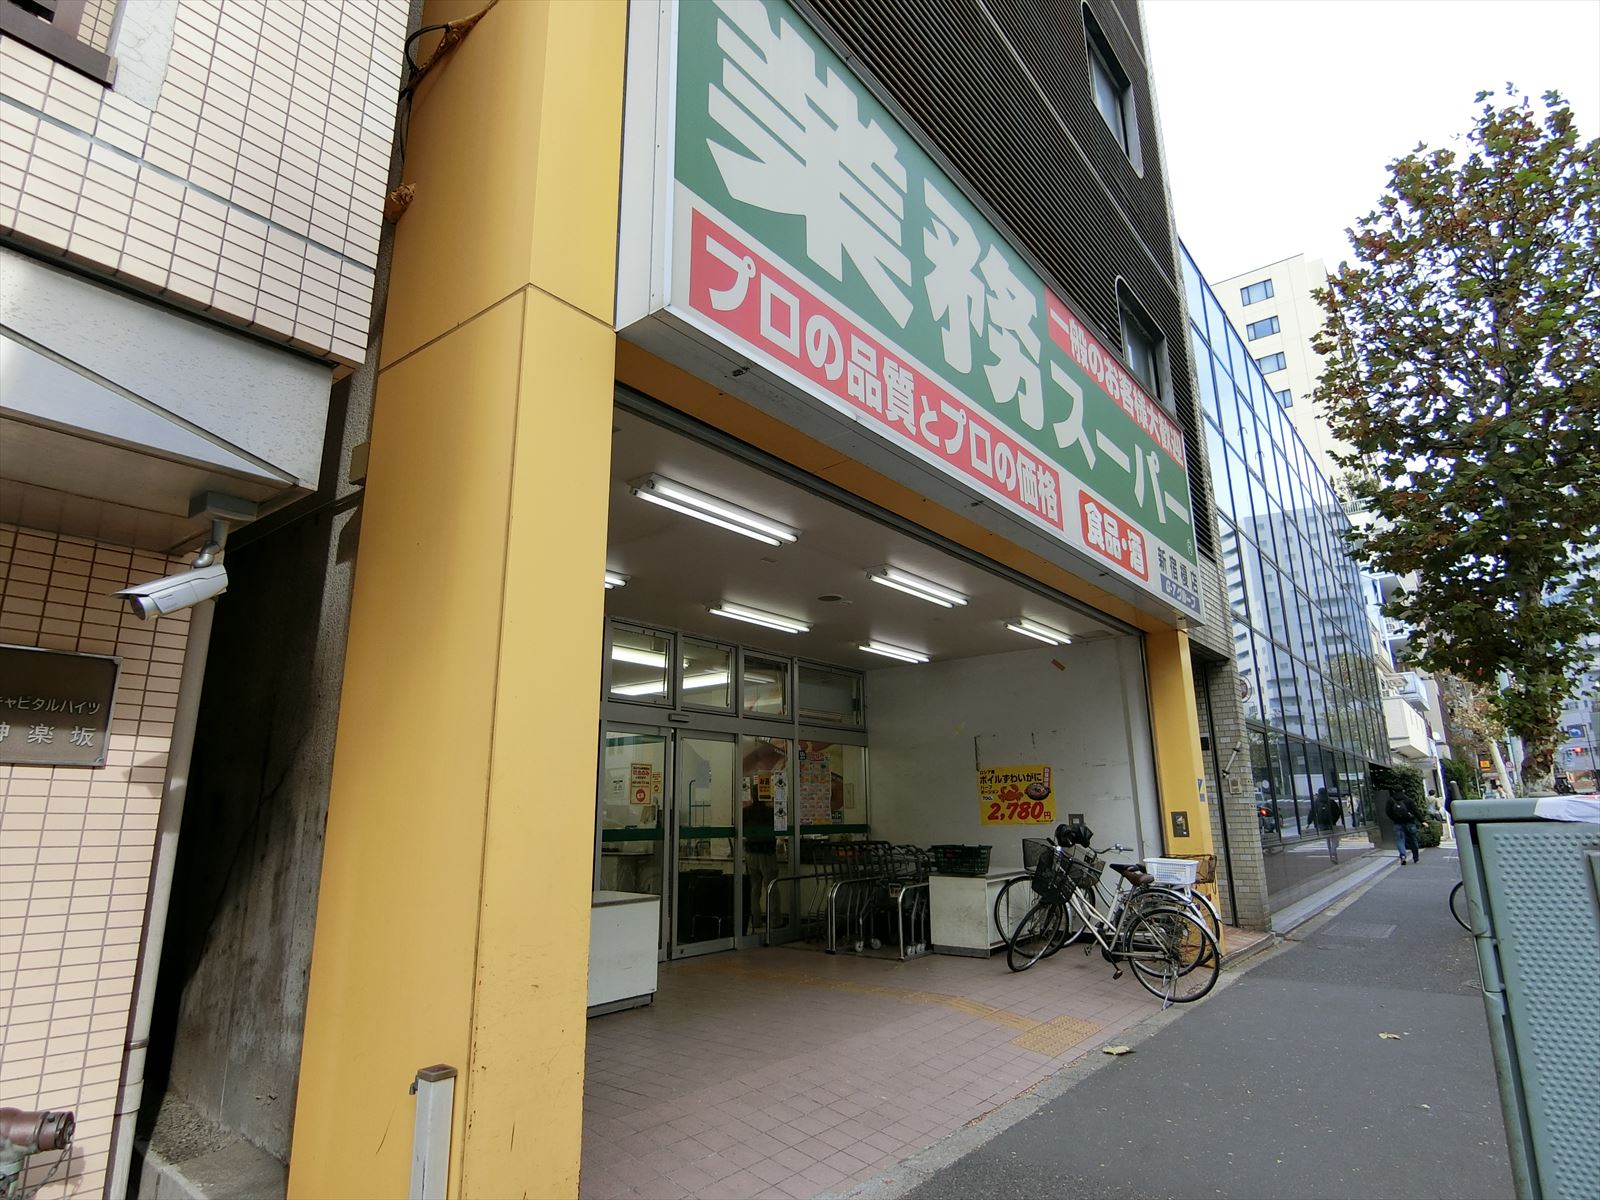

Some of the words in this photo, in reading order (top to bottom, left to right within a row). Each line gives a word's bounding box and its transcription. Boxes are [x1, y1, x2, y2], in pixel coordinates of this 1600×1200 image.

[706, 0, 1190, 526] 業務スーパー
[706, 234, 1059, 523] プロの品質とプロの価格
[1050, 308, 1184, 467] 一般のお客様大歓迎
[988, 801, 1051, 820] 2,780円
